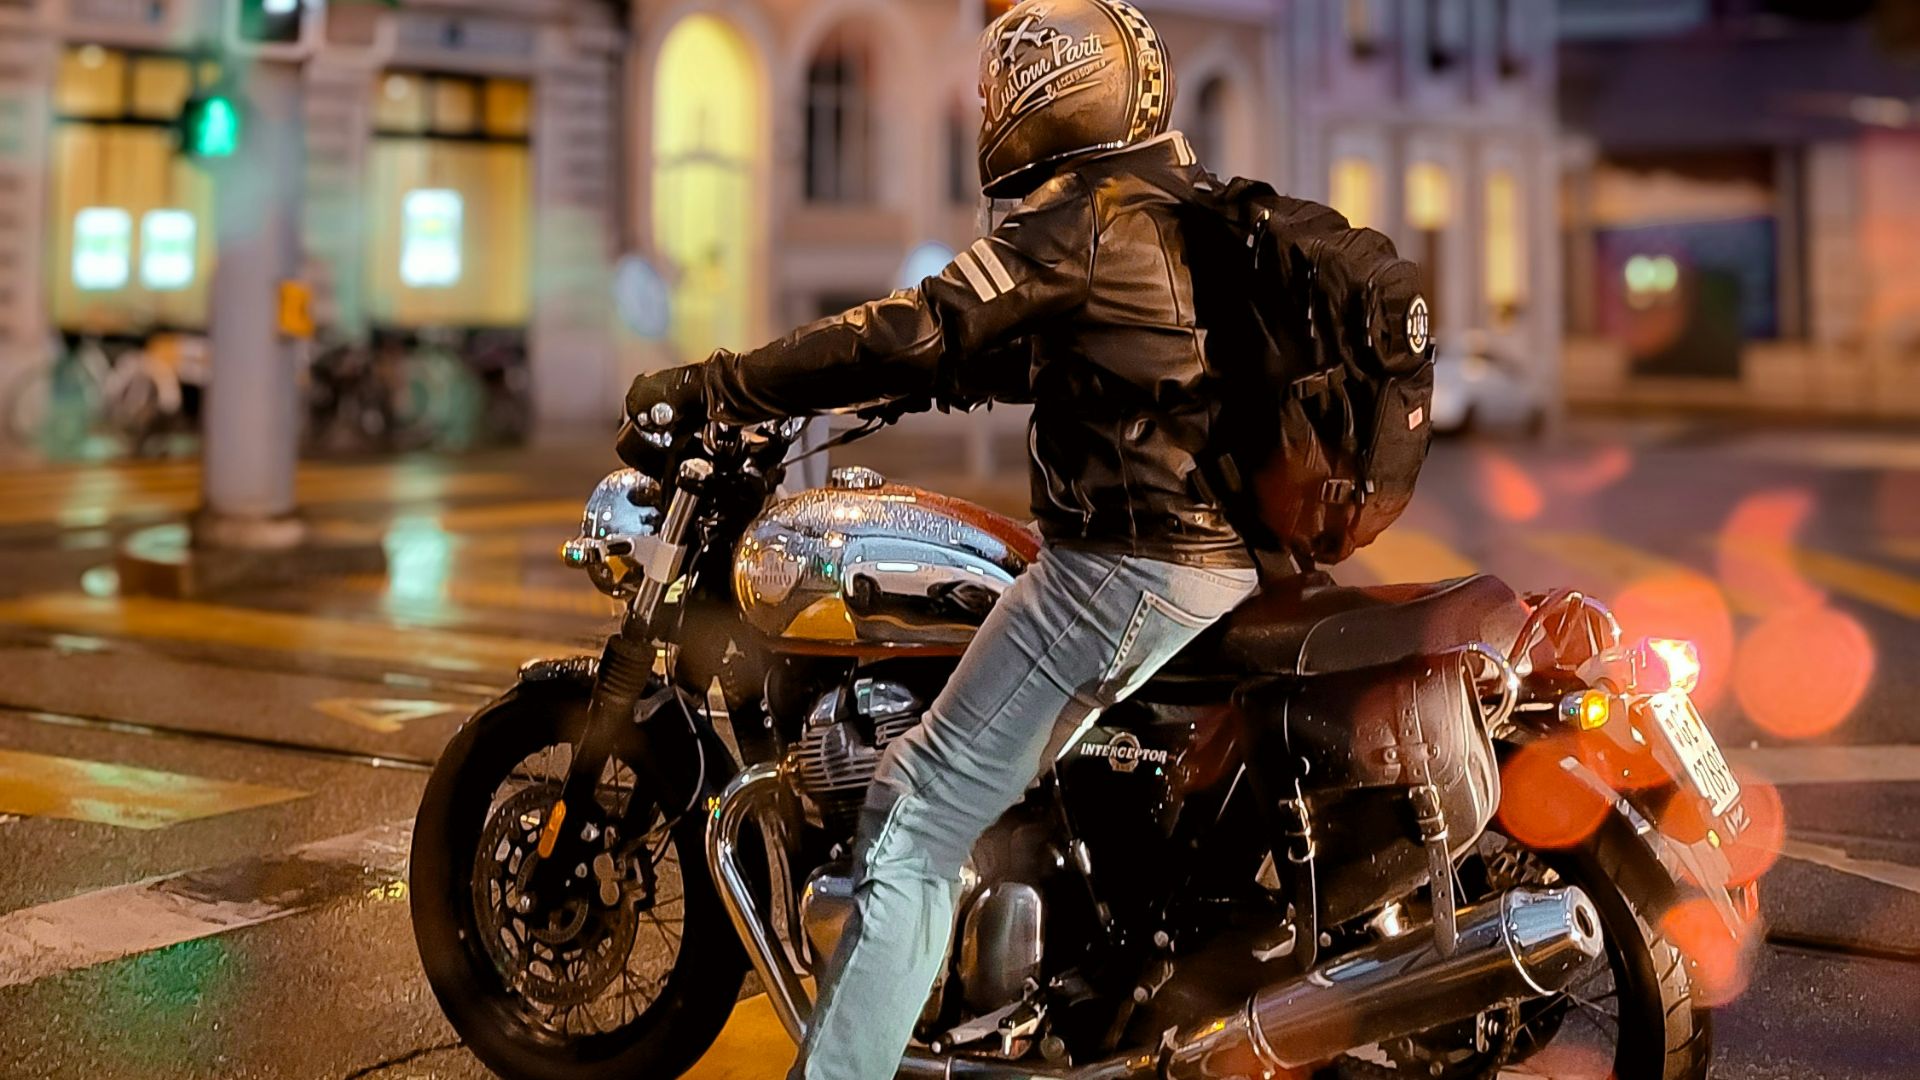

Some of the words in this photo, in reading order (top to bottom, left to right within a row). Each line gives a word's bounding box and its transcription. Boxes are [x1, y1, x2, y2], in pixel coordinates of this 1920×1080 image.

[990, 59, 1051, 122] Custom
[1044, 32, 1105, 67] Parts
[1045, 83, 1057, 100] &
[1080, 742, 1168, 765] INTERCEPTOR
